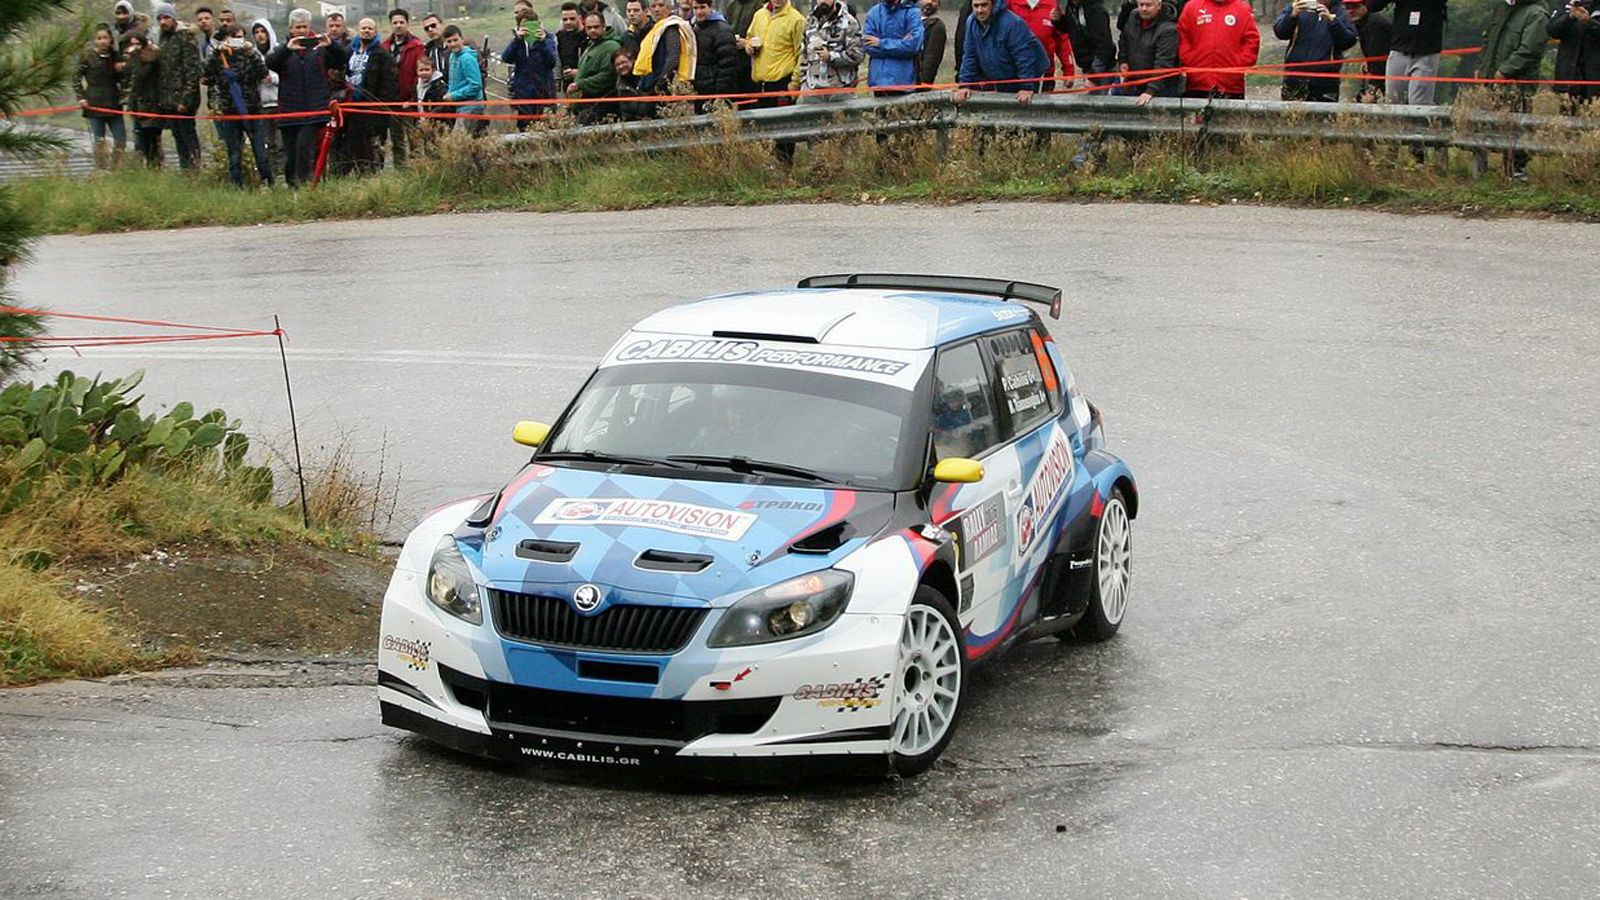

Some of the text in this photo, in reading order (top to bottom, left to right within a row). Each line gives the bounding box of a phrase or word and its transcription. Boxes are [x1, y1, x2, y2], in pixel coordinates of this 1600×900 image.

[616, 339, 910, 375] CABILIS PERFORMANCE
[1032, 435, 1071, 517] AUTOVISION
[607, 501, 741, 529] AUTOVISION
[963, 504, 986, 543] RALLY
[794, 683, 877, 700] CABILIS
[520, 747, 640, 766] WWW.CABILIS.GR
